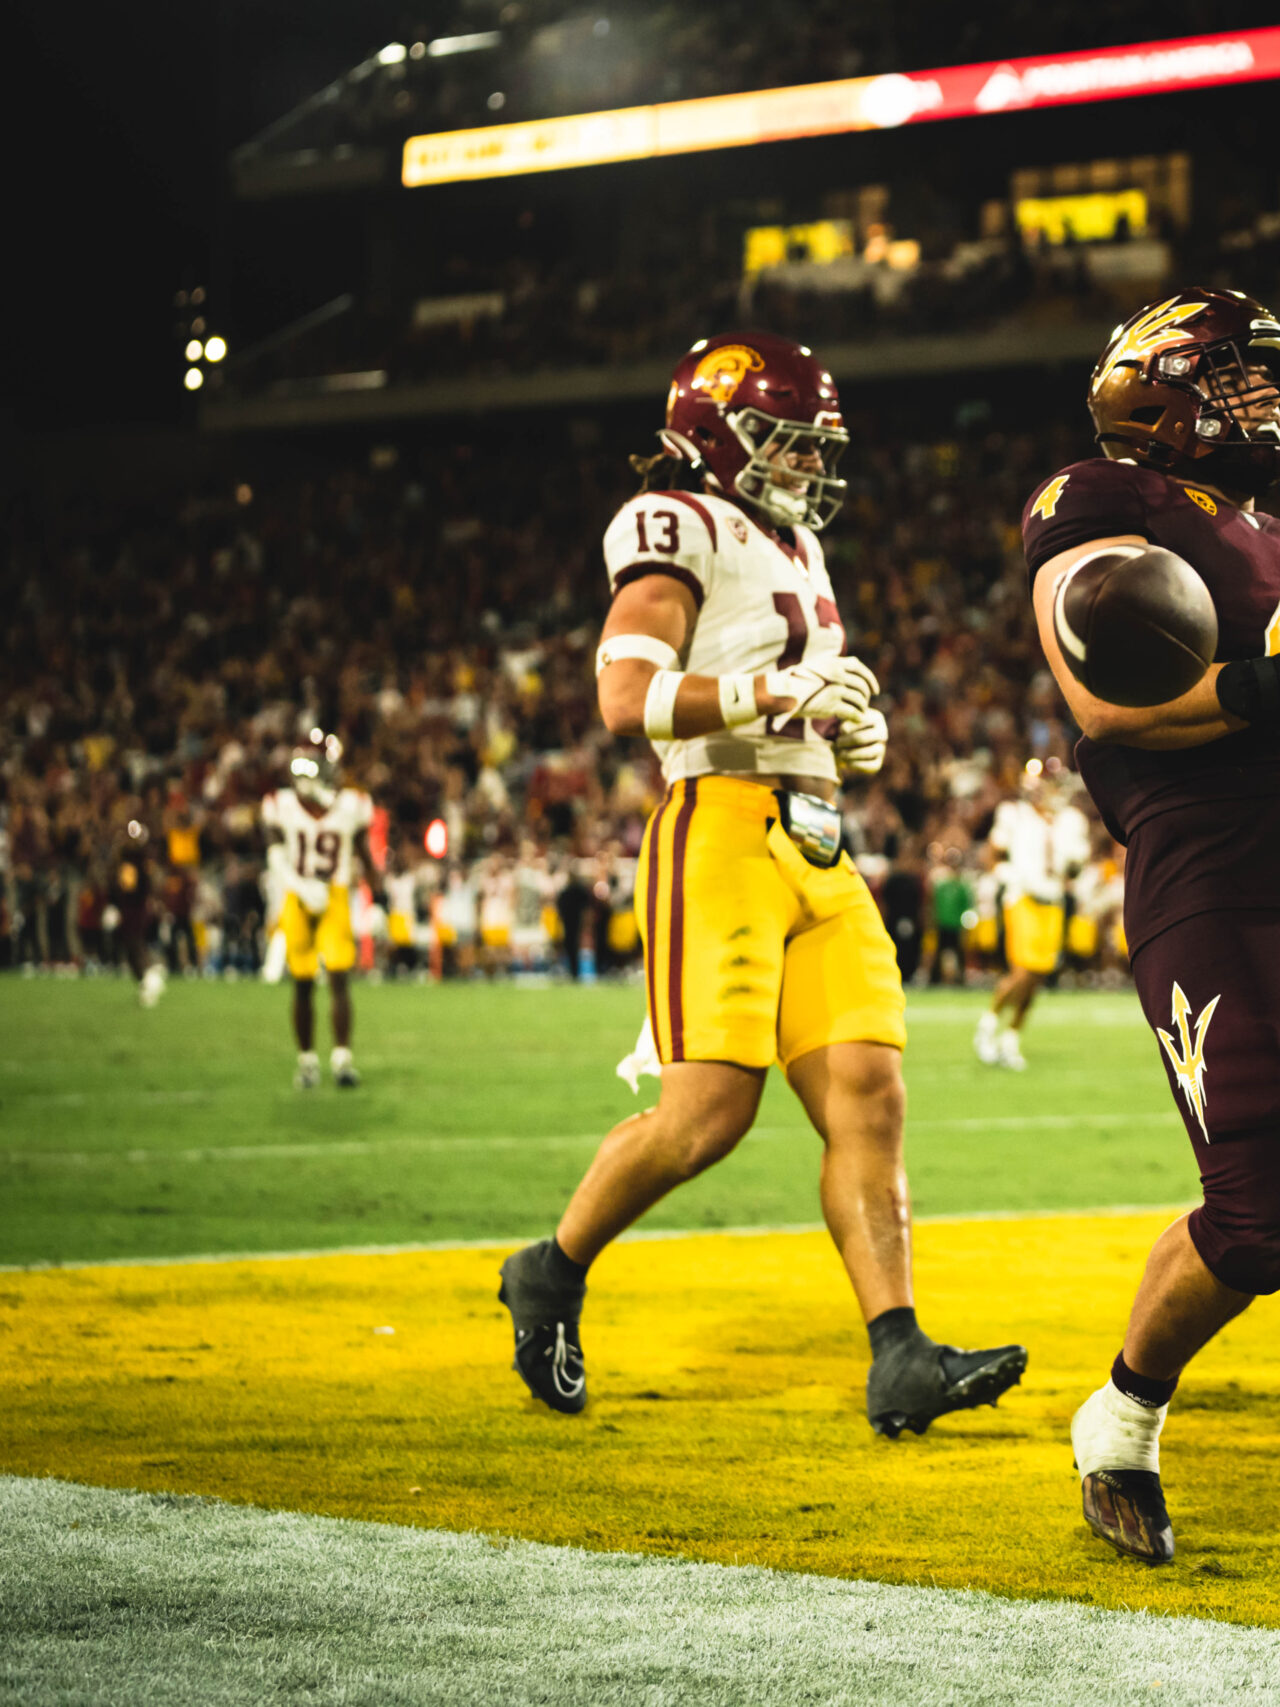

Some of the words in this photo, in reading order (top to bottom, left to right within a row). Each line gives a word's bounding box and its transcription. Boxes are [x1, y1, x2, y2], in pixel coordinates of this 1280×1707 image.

[1030, 473, 1070, 520] 4
[635, 511, 680, 554] 13
[297, 831, 341, 878] 19
